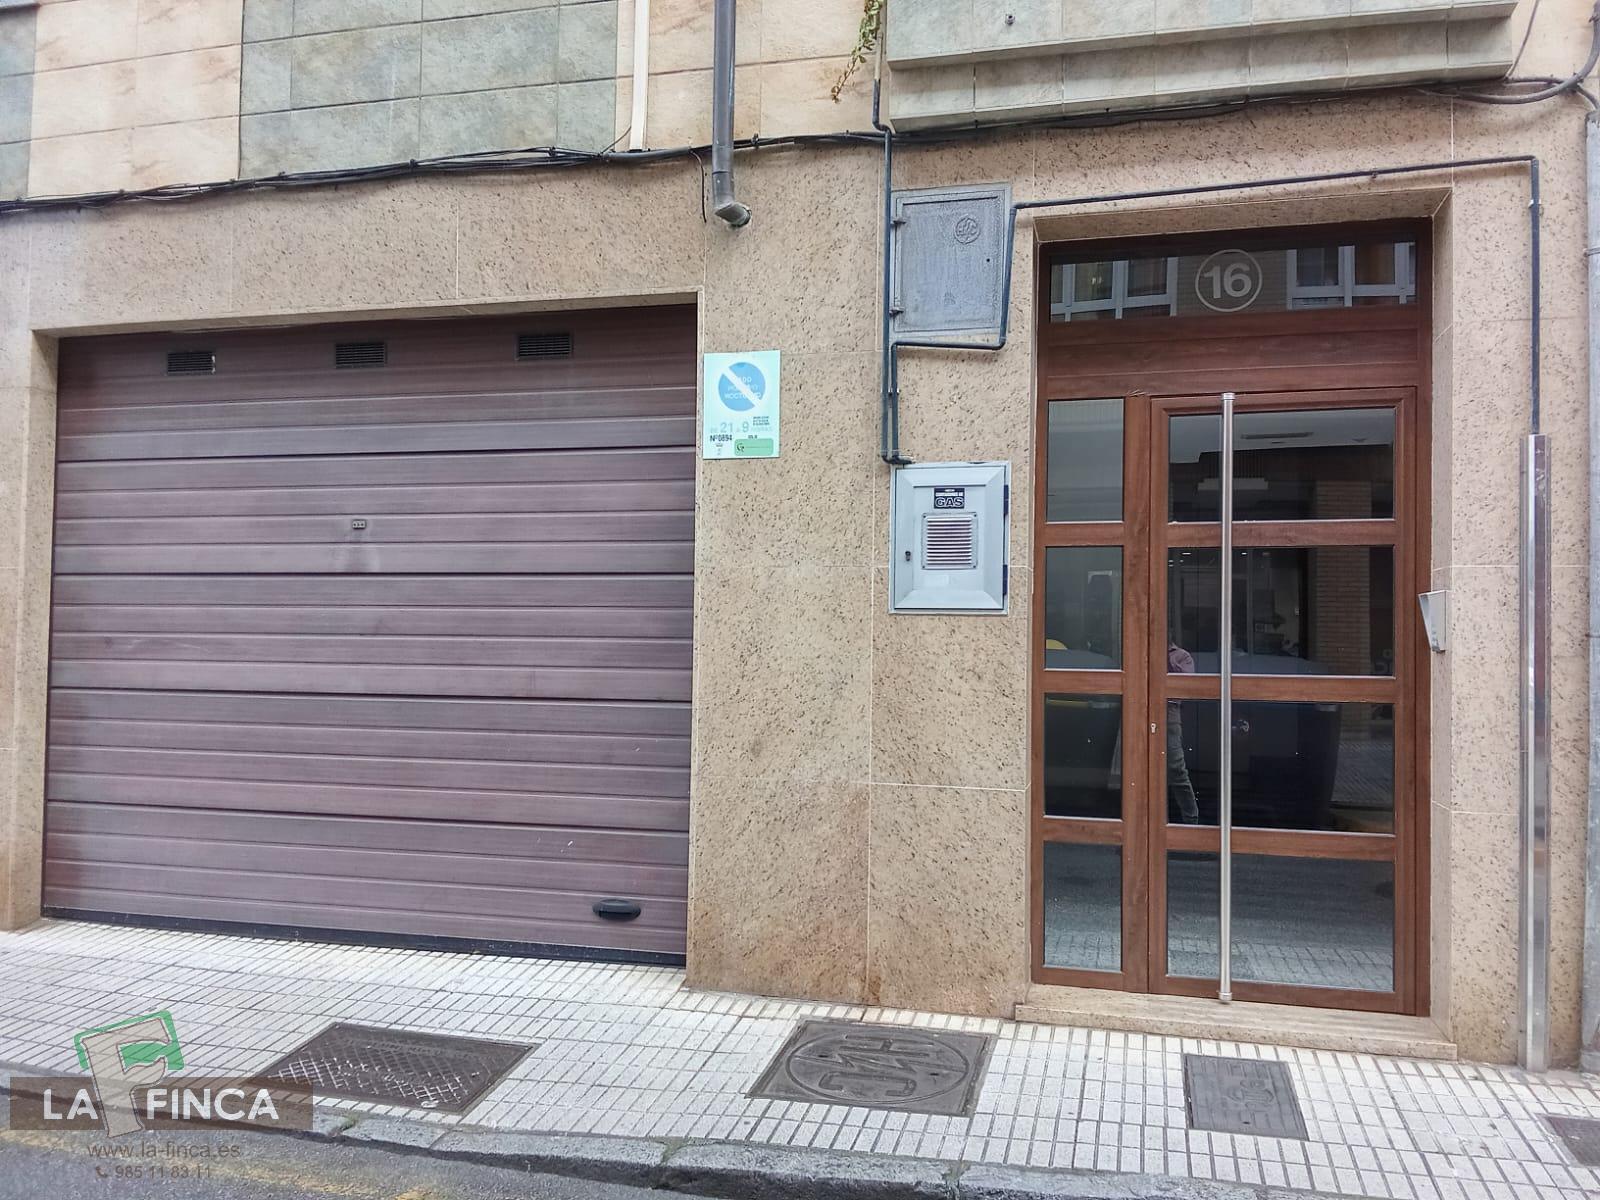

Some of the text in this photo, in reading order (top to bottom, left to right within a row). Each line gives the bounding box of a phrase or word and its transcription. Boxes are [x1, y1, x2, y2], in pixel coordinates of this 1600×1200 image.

[1203, 262, 1253, 300] 16
[720, 422, 733, 433] 21
[936, 496, 964, 508] GAS
